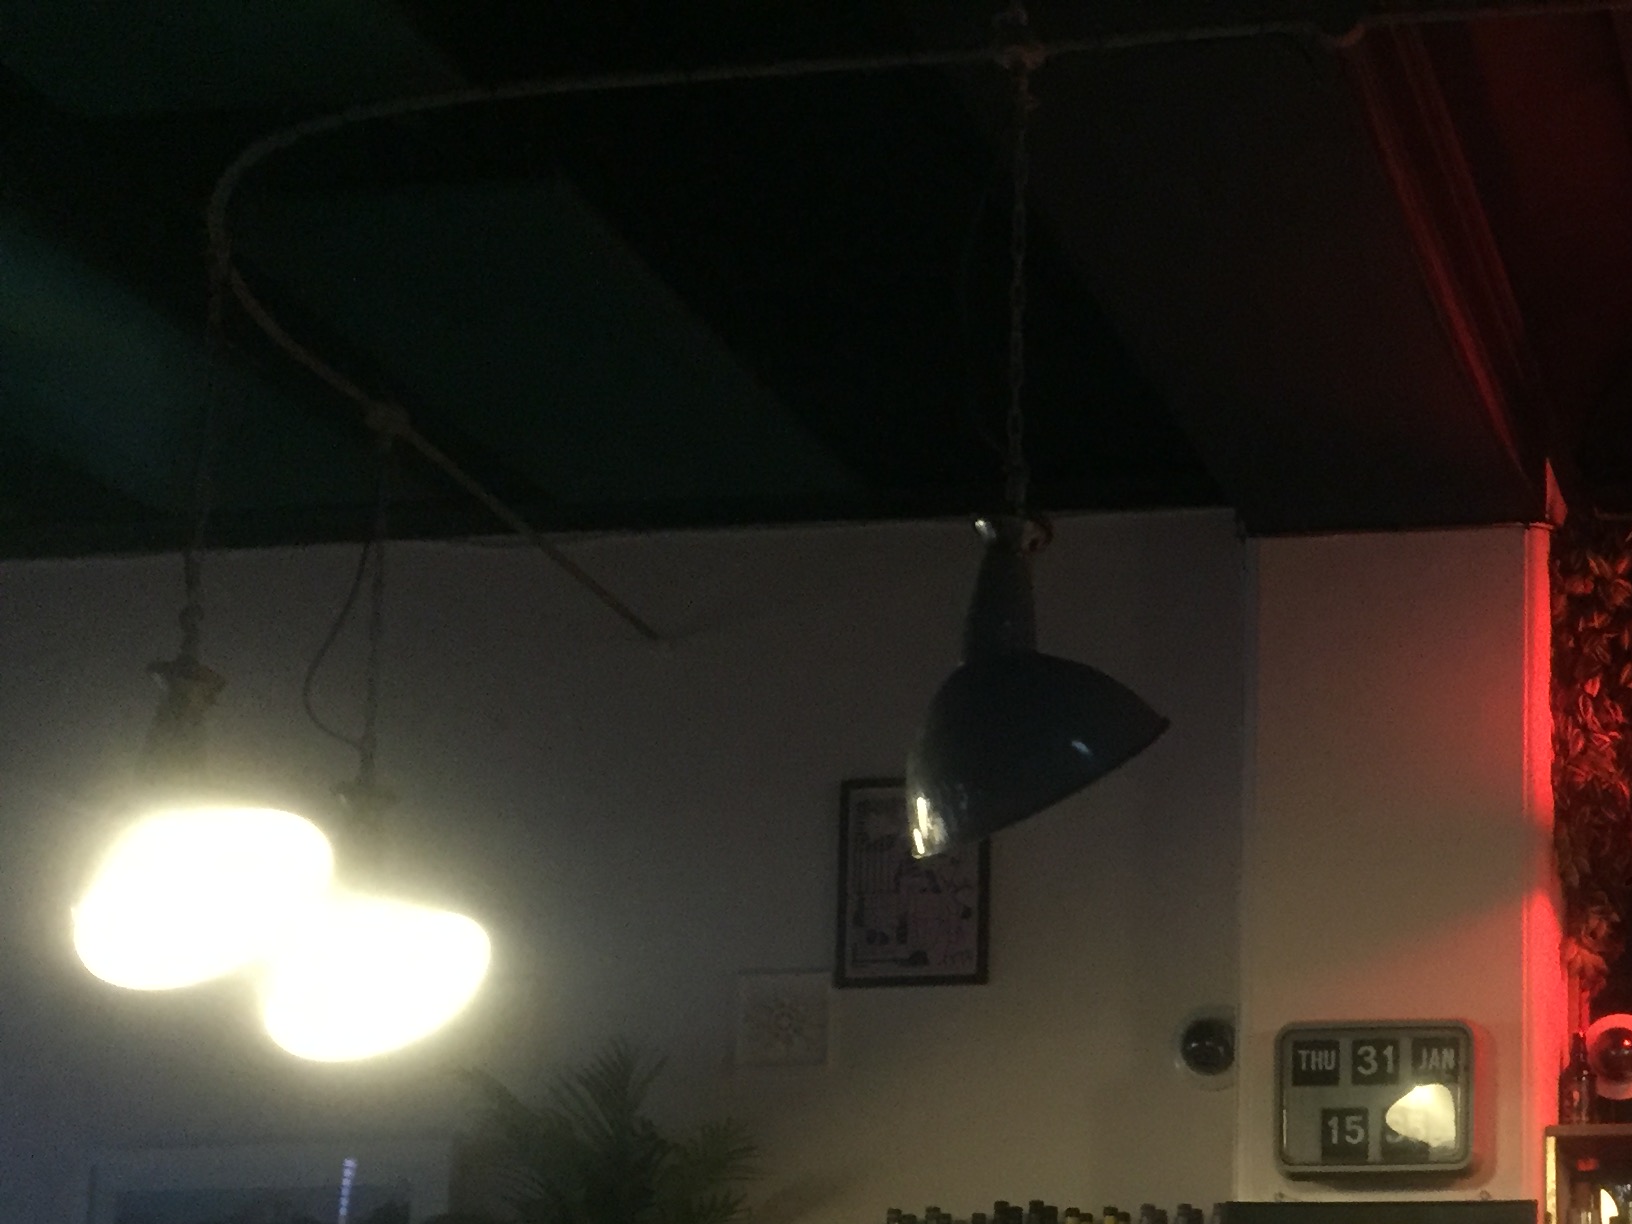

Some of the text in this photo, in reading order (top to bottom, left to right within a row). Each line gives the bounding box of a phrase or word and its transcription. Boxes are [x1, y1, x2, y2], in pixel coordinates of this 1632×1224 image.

[1297, 1044, 1456, 1076] THU 31 JAN
[1327, 1114, 1366, 1146] 15
